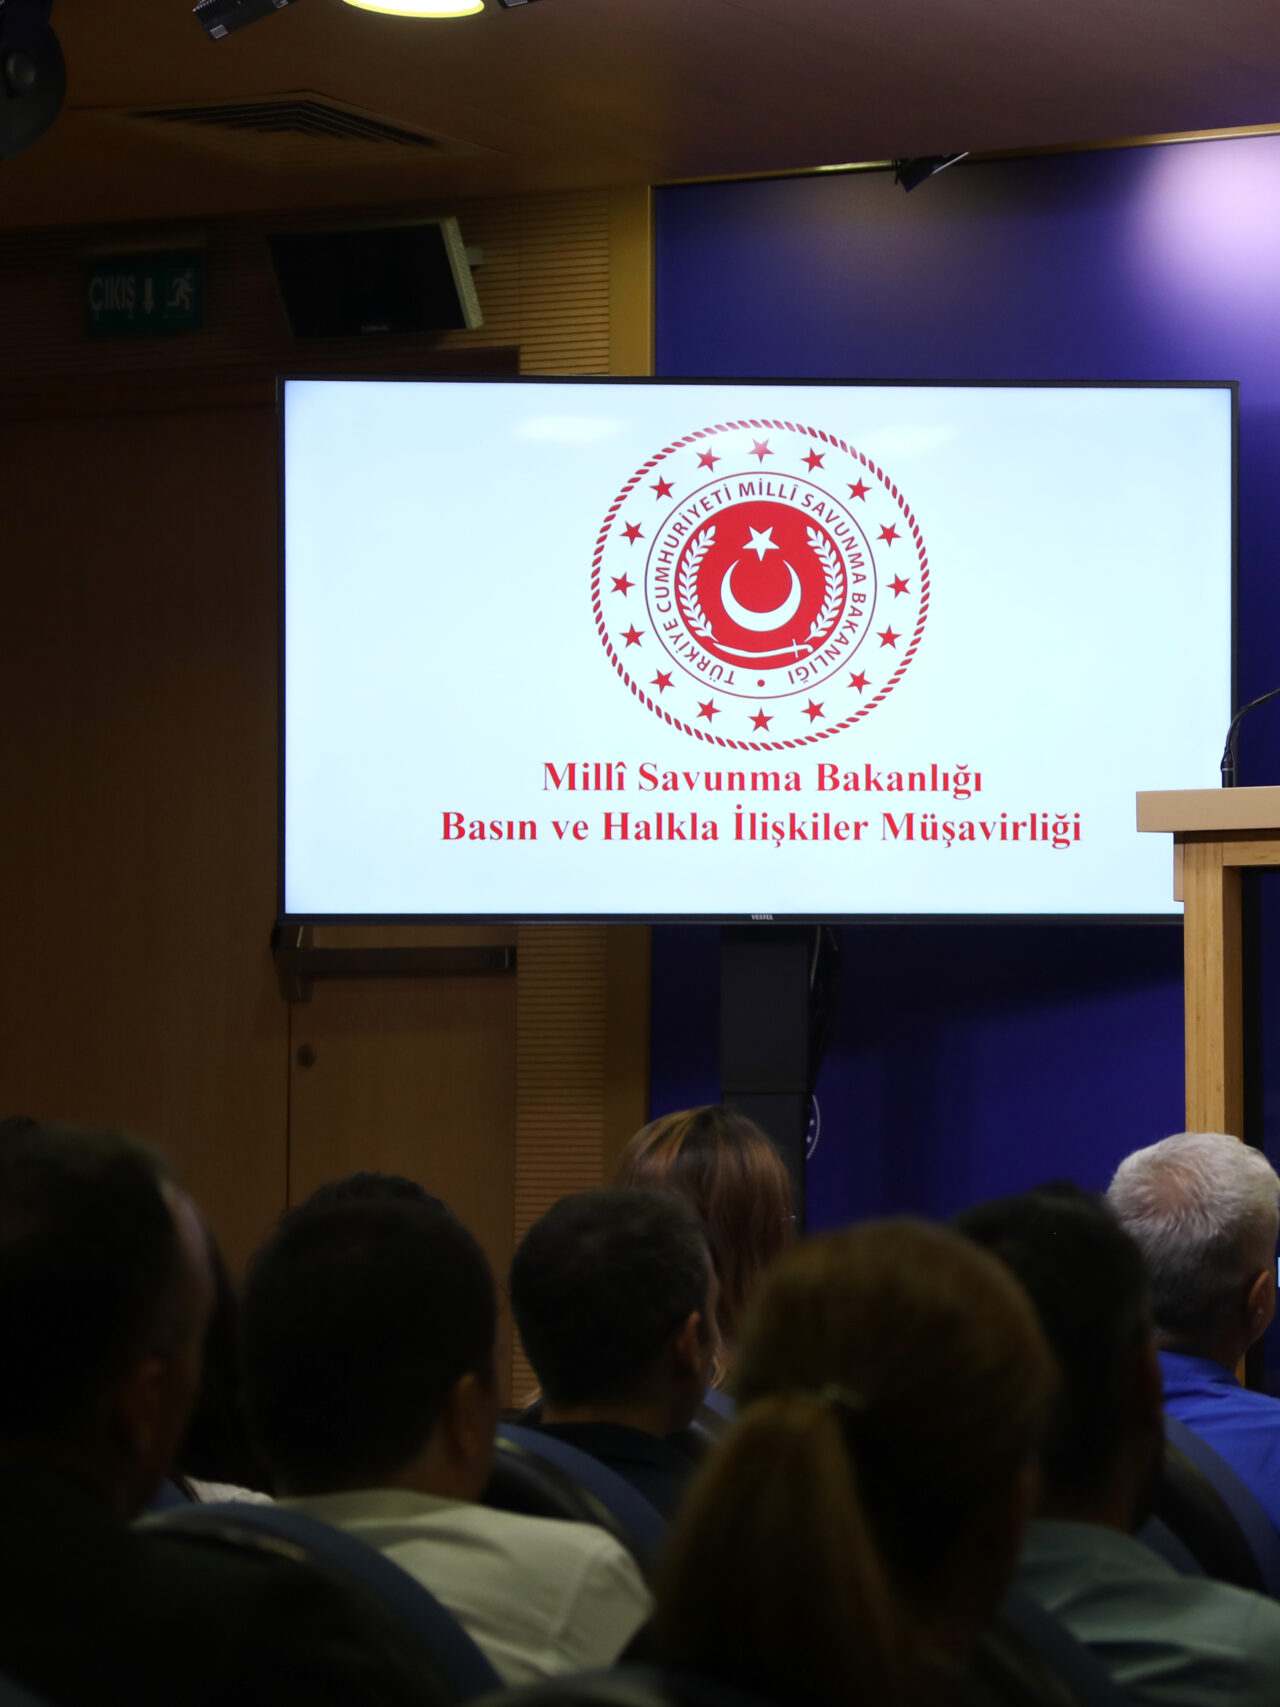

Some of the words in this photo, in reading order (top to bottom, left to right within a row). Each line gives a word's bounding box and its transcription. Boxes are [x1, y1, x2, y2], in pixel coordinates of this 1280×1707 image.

[88, 274, 136, 320] ÇIKIŞ
[738, 478, 799, 500] MİLLÎ
[654, 483, 732, 613] CUMHURİYETİ
[801, 493, 867, 584] SAVUNMA
[663, 618, 735, 685] TÜRKİYE
[787, 593, 867, 685] BAKANLIĞI
[543, 762, 627, 792] Millî
[639, 763, 802, 792] Savunma
[816, 763, 983, 800] Bakanlığı
[440, 812, 538, 841] Basın
[551, 820, 589, 841] ve
[602, 811, 720, 841] Halkla
[734, 804, 869, 848] İlişkiler
[881, 812, 1082, 849] Müşavirliği
